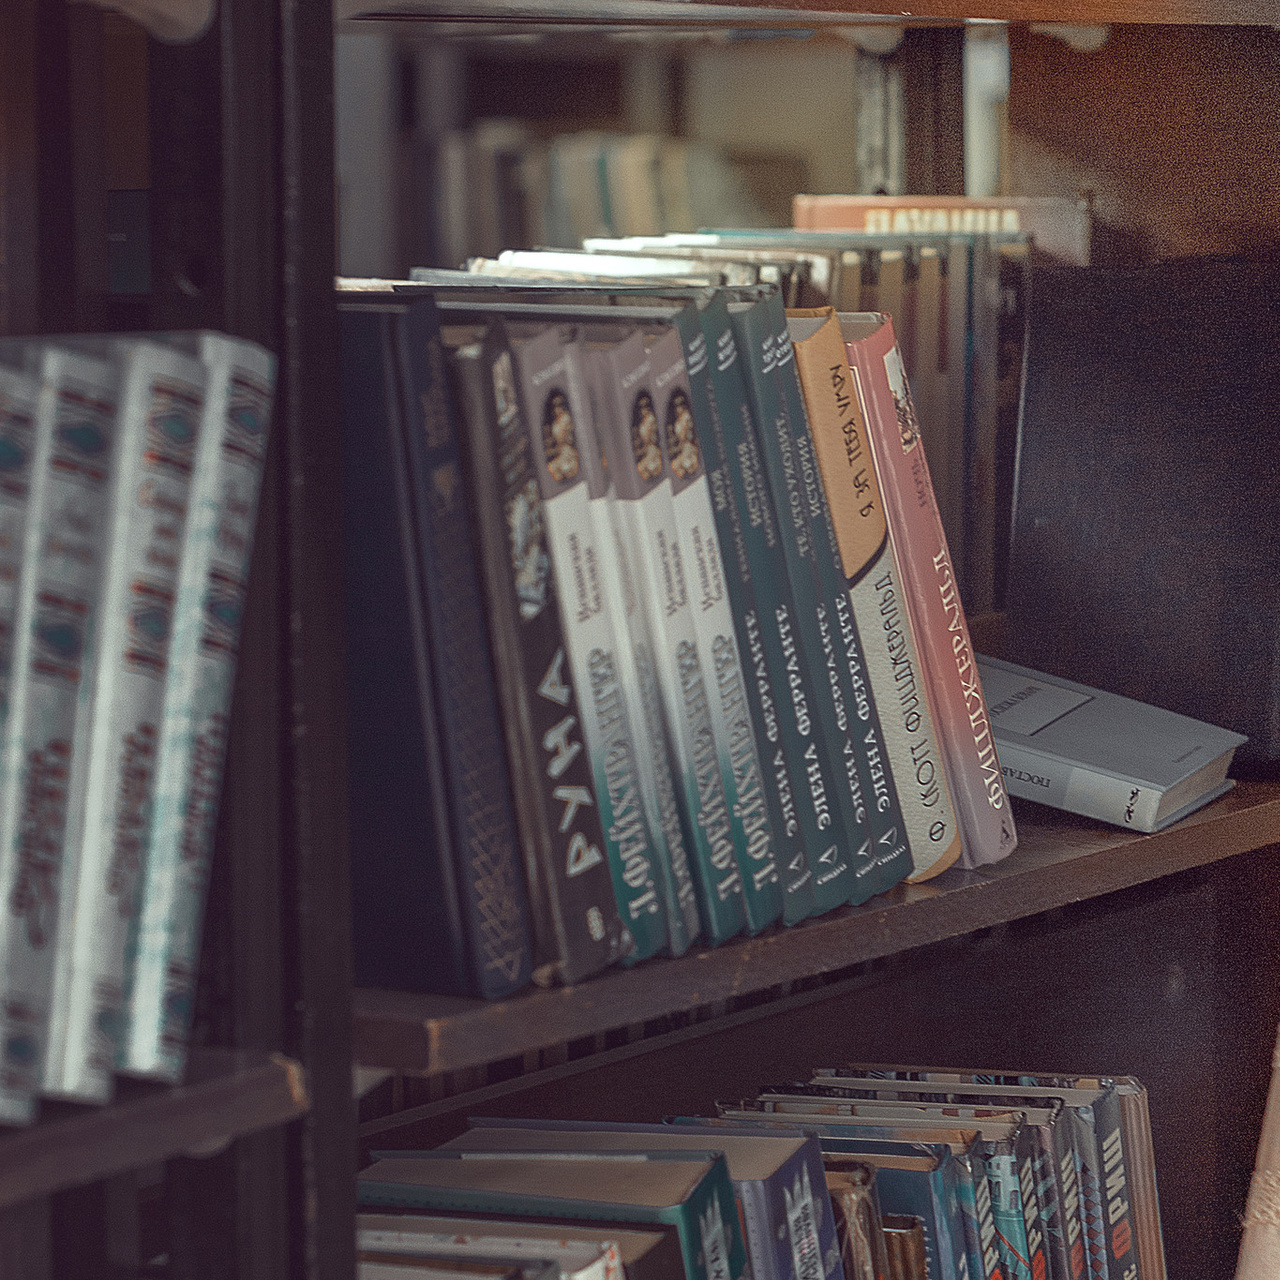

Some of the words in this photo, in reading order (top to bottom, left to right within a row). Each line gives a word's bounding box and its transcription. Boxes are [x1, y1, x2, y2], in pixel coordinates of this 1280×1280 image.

[826, 362, 853, 417] УМРУ
[733, 442, 764, 528] ИСТОРИЯ
[792, 435, 824, 517] ИСТОРИЯ
[838, 417, 865, 467] ТЕБЯ
[850, 467, 872, 498] ЗА
[858, 501, 875, 518] Я
[741, 608, 780, 744] ФЕРРАНТЕ
[769, 602, 815, 737] ФЕРРАНТЕ
[812, 602, 849, 732] ФЕРРАНТЕ
[830, 591, 872, 721] ФЕРРАНТЕ
[871, 570, 926, 733] ФИЦДЖЕРАЛЬД
[930, 544, 1006, 812] ФИЦДЖЕРАЛЬД
[523, 645, 607, 879] РУНА
[769, 748, 798, 837] ЭЛЕНА
[799, 741, 833, 831] ЭЛЕНА
[840, 738, 867, 824] ЭЛЕНА
[860, 727, 891, 813] ЭЛЕНА
[907, 737, 942, 809] СКОТТ
[1055, 1148, 1089, 1280] Фриш
[1093, 1126, 1138, 1259] Фриш
